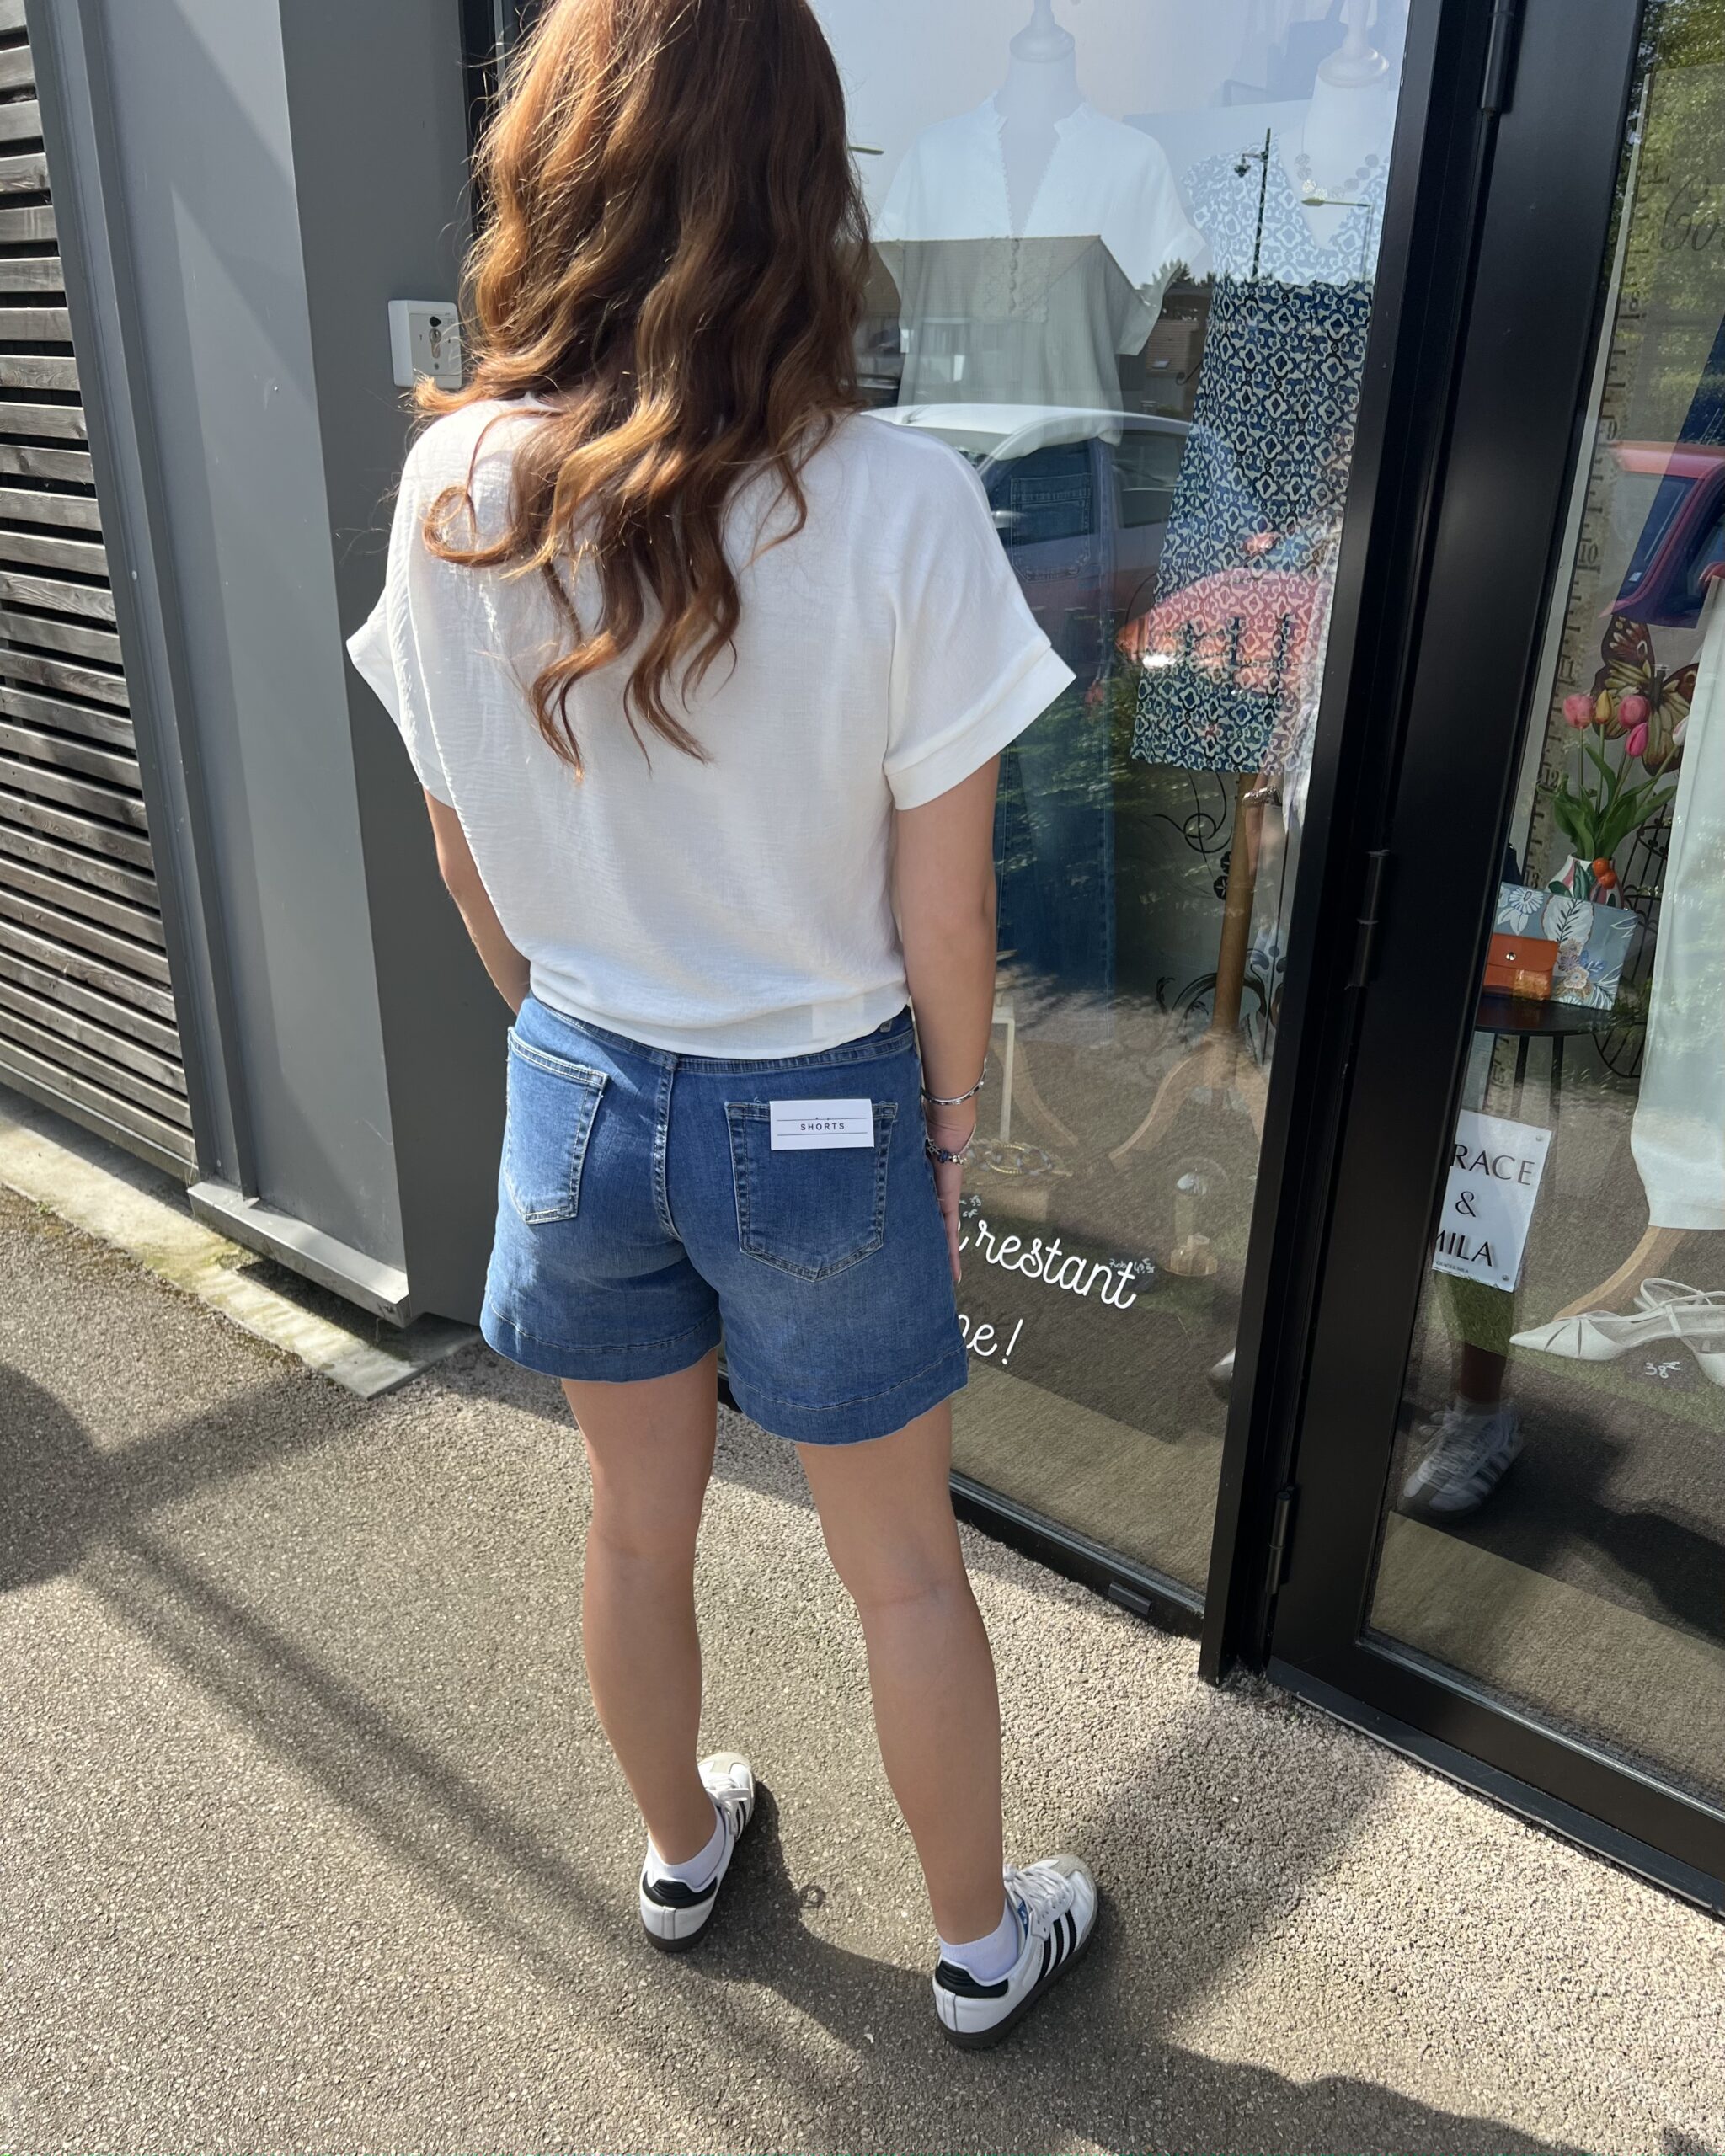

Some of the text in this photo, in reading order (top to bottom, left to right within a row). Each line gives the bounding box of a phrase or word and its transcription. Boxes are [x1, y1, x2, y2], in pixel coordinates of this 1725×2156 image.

[1579, 543, 1599, 563] 10
[1542, 769, 1560, 788] 12
[800, 1122, 845, 1131] SHORTS
[1455, 1191, 1477, 1218] &
[975, 1219, 1137, 1310] restant
